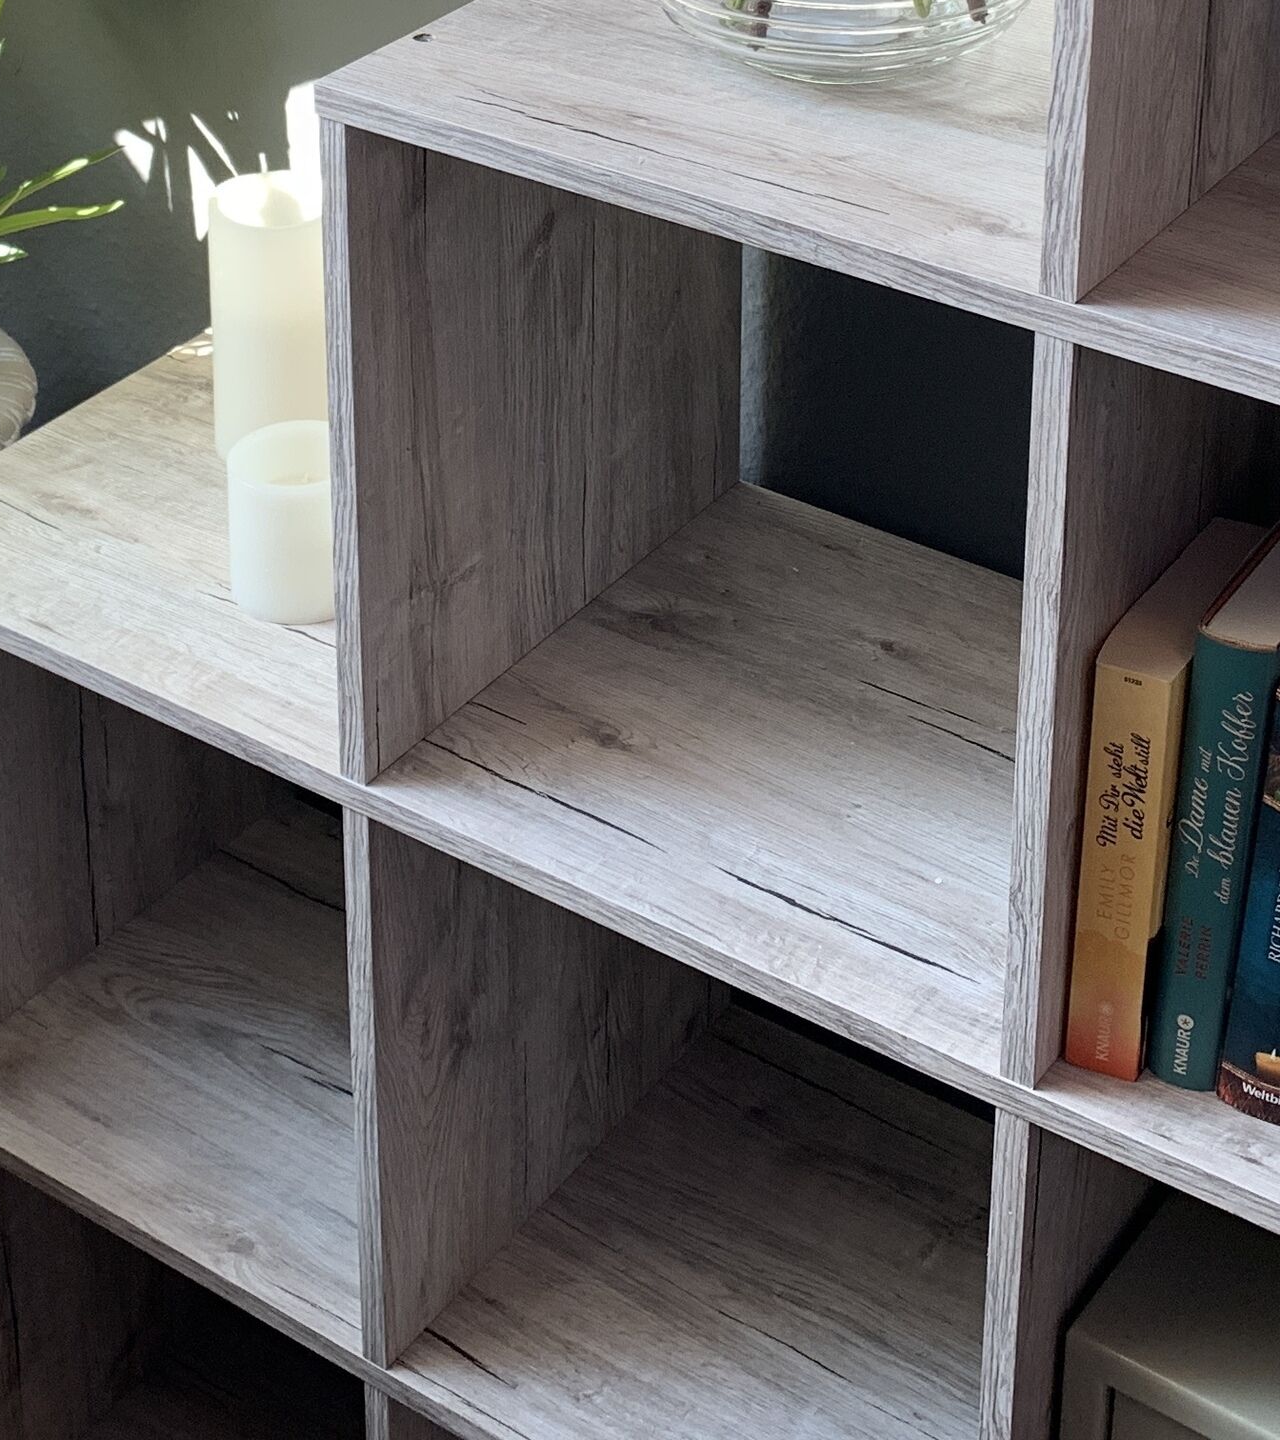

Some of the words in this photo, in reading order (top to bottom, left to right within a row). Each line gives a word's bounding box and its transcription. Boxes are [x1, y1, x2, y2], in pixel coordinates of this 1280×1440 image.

[1130, 732, 1151, 766] still
[1217, 690, 1257, 781] Koffer
[1103, 742, 1124, 779] steht
[1098, 784, 1121, 813] Dir
[1121, 763, 1149, 804] Welt
[1178, 777, 1209, 854] Dame
[1198, 745, 1213, 773] mit
[1095, 815, 1118, 848] Mit
[1122, 809, 1145, 840] die
[1206, 787, 1242, 871] blauen
[1096, 862, 1116, 921] EMILY
[1114, 854, 1137, 940] GILLMOR
[1213, 877, 1231, 904] dem
[1096, 1014, 1113, 1061] KNAUR
[1173, 1028, 1191, 1076] KNAUR
